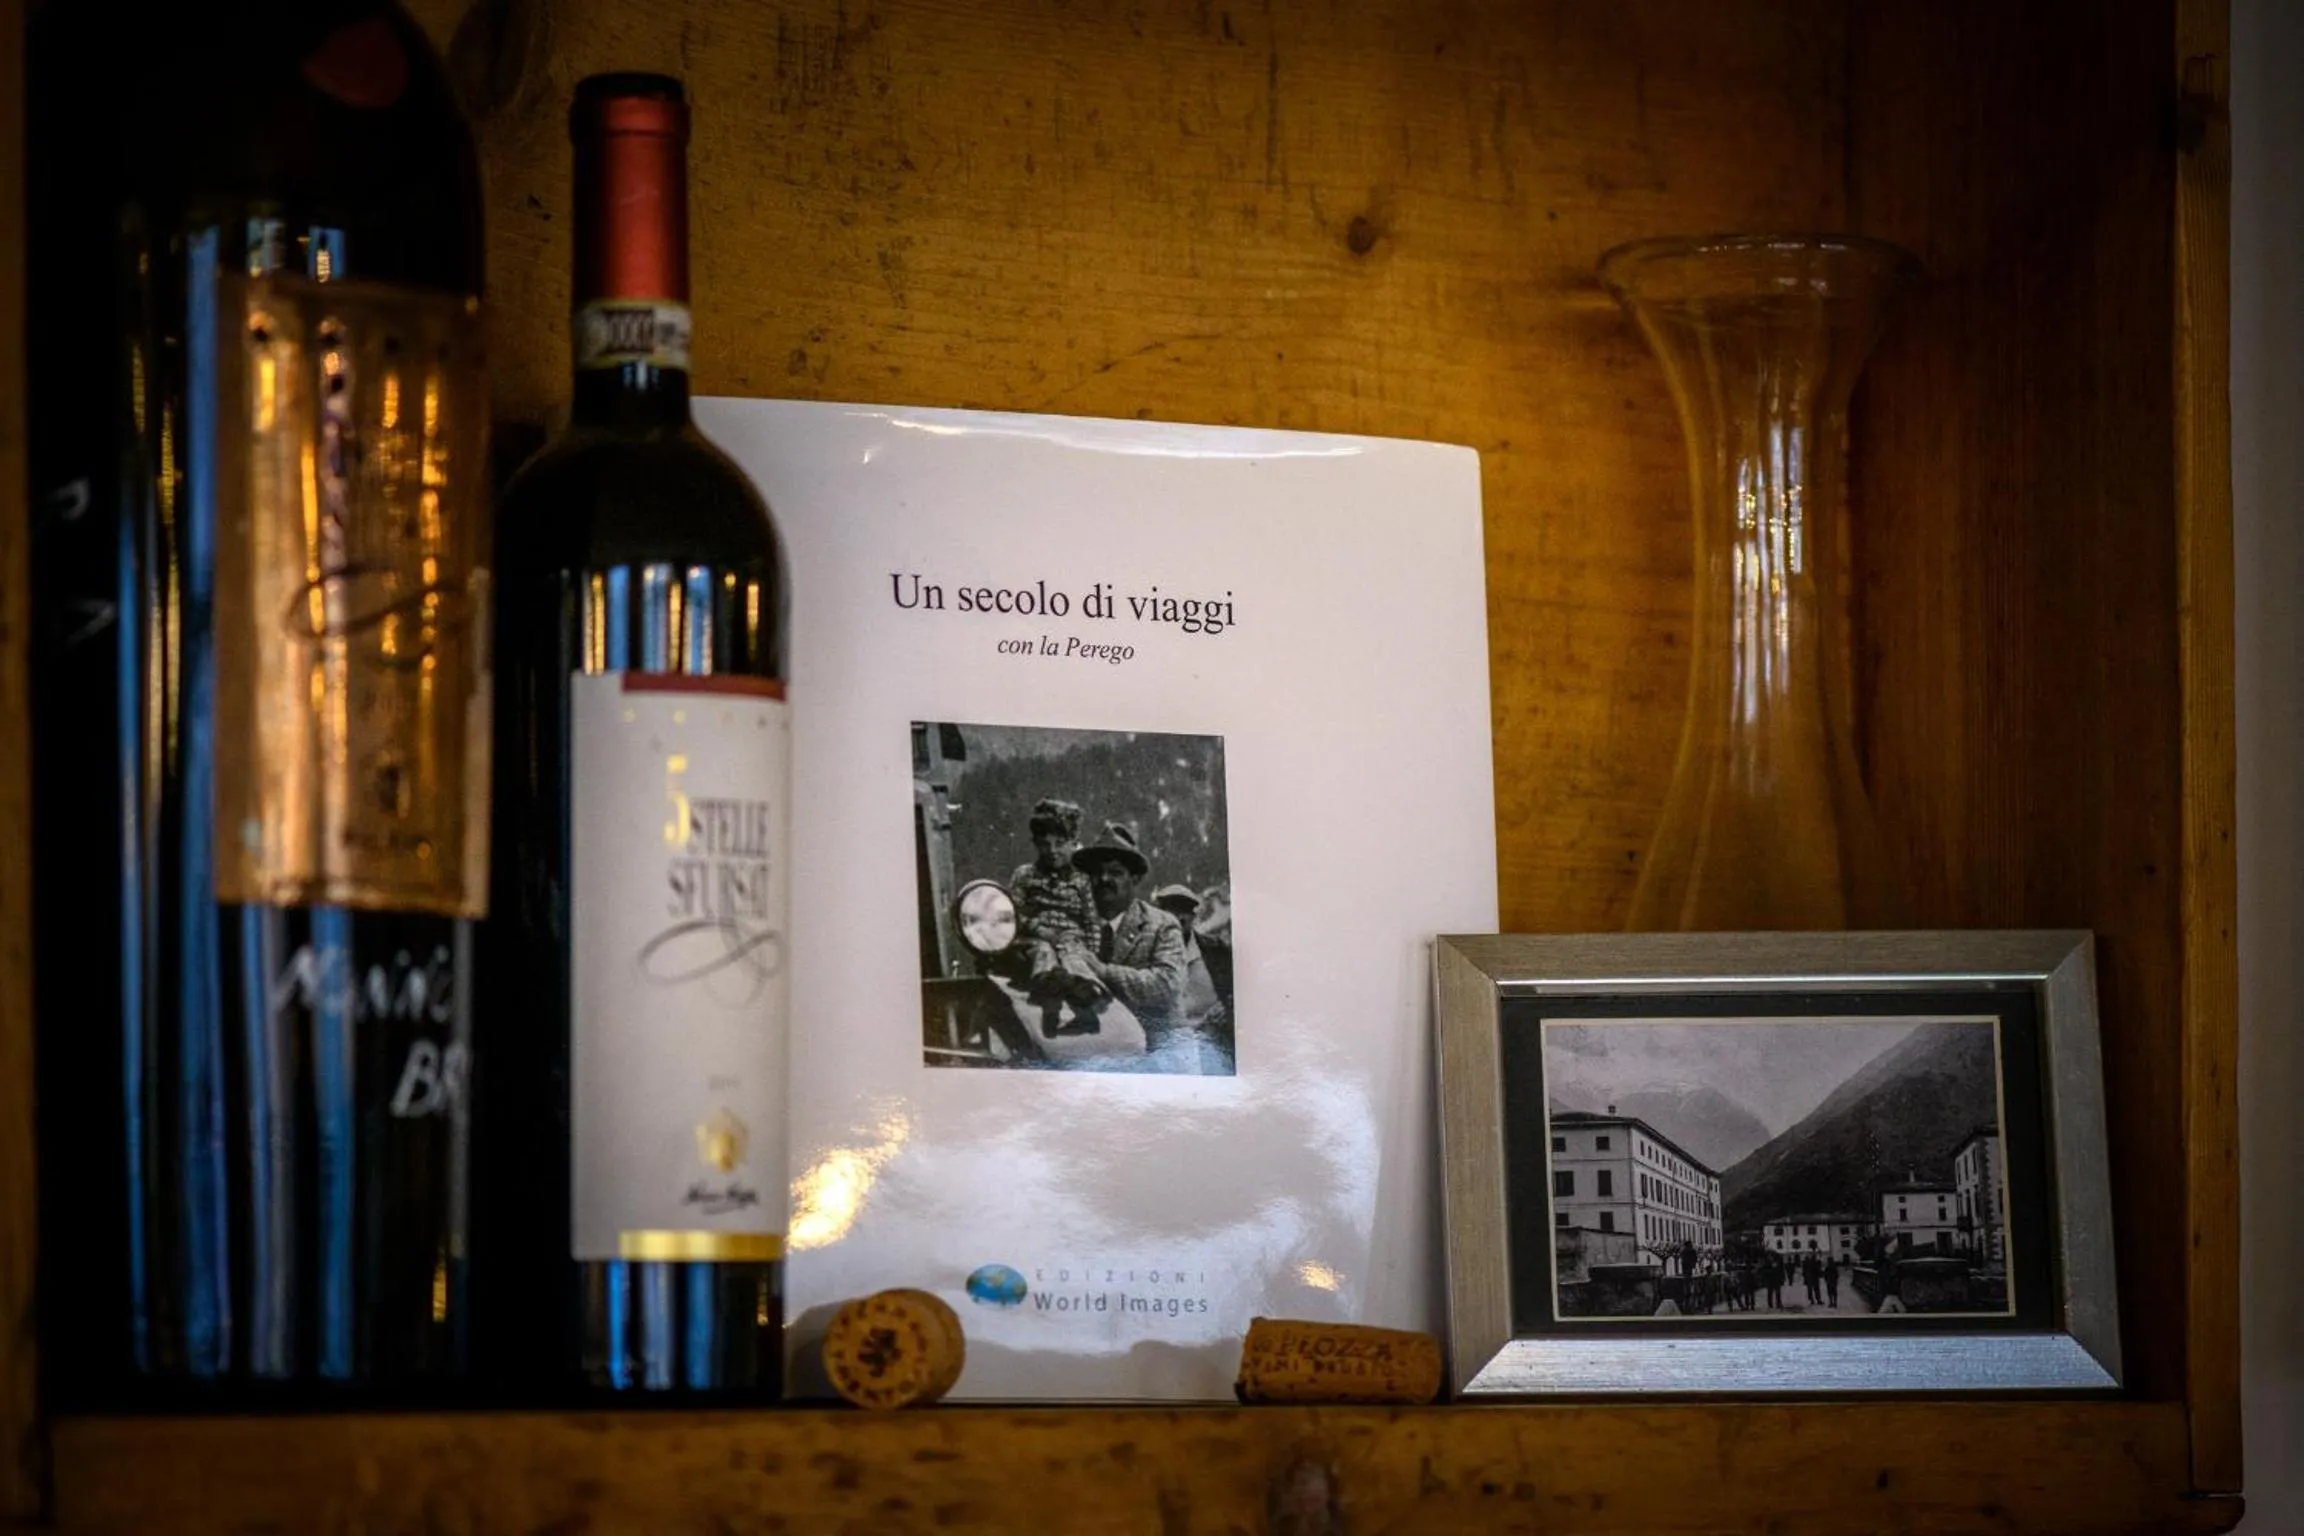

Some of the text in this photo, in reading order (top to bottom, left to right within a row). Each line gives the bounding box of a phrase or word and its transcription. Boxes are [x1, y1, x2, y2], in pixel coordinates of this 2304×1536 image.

[889, 573, 1236, 635] Un secolo di viaggi
[997, 635, 1135, 664] con la Perego
[1033, 1293, 1208, 1318] World Images
